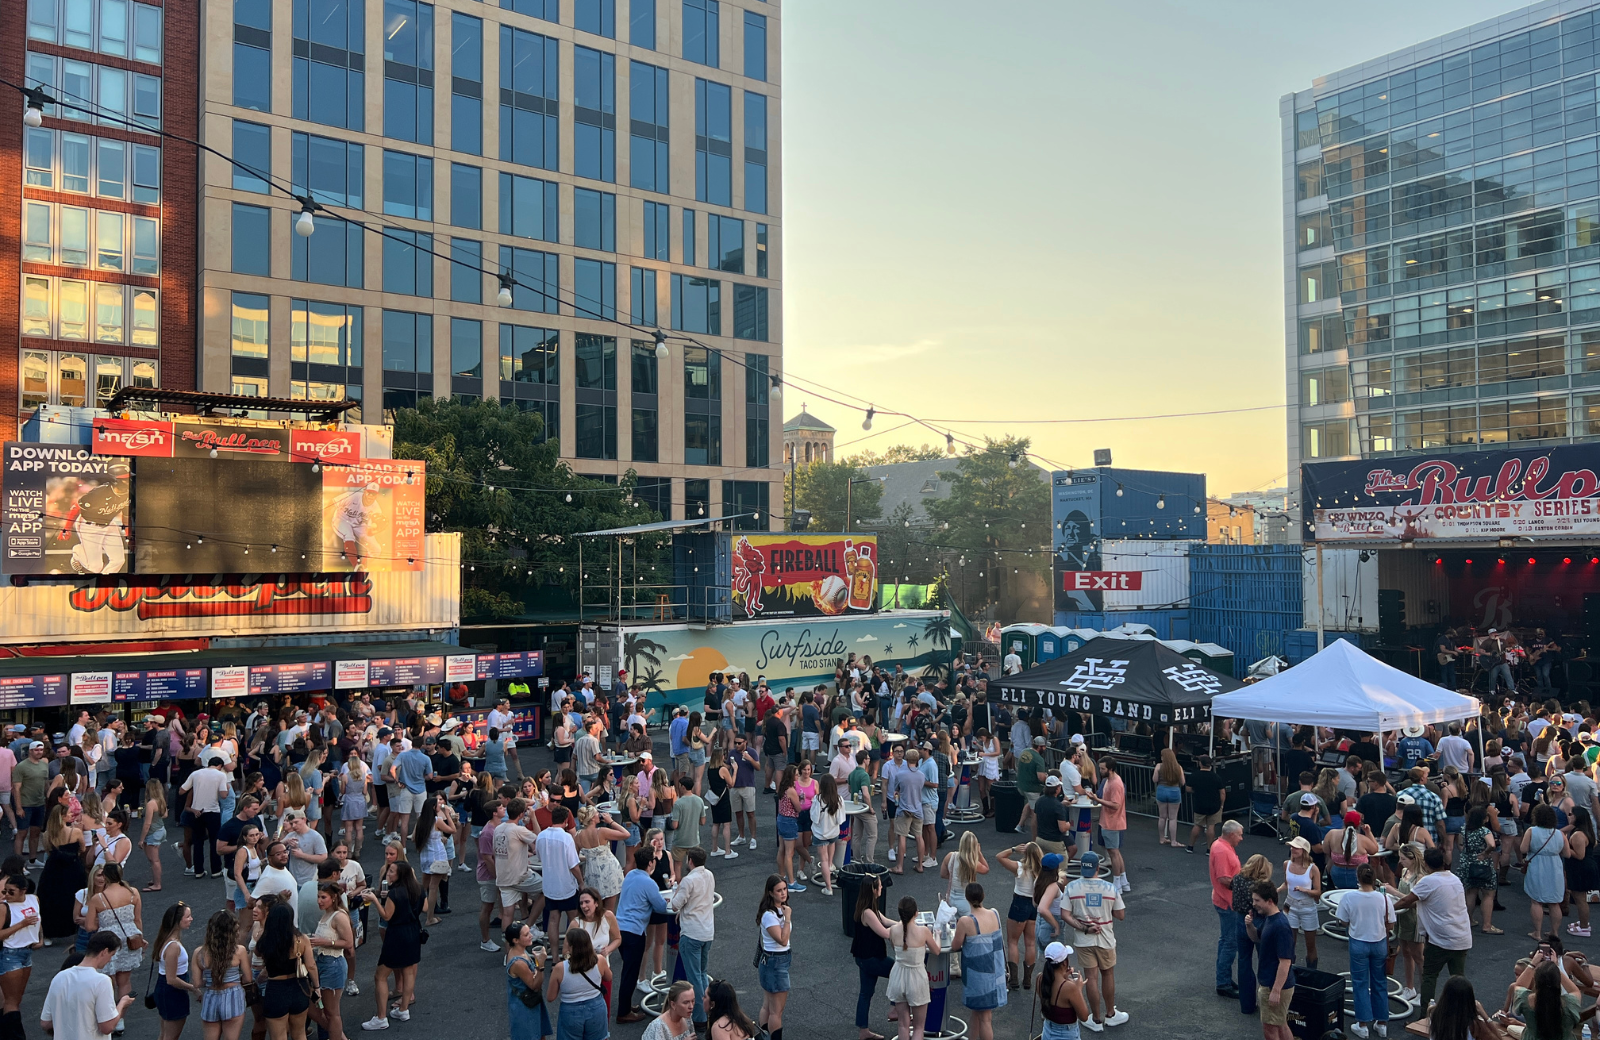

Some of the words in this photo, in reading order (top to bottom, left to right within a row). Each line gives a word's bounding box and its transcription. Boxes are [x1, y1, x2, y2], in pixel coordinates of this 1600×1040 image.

[195, 430, 281, 450] Bullpen
[296, 437, 352, 457] masn
[10, 460, 45, 472] APP
[48, 461, 108, 474] TODAY!
[322, 464, 395, 475] OWNLOAD
[395, 466, 421, 475] THE
[346, 475, 375, 484] APP
[377, 476, 421, 486] TODAY!
[1365, 469, 1408, 490] The
[1401, 456, 1600, 506] Bullp
[9, 497, 42, 507] LIVE
[396, 507, 420, 516] LIVE
[1347, 511, 1385, 521] WMZQ
[1434, 503, 1523, 520] COUNTRY
[1534, 499, 1591, 517] SERIES
[9, 522, 43, 534] APP
[396, 528, 420, 538] APP
[771, 549, 840, 575] FIREBALL
[1074, 573, 1130, 590] Exit
[756, 629, 848, 670] Surfside
[799, 660, 818, 670] TACO
[1001, 687, 1026, 703] ELI
[1037, 690, 1091, 711] YOUNG
[1102, 697, 1153, 721] BAND
[1174, 706, 1196, 721] ELI
[1407, 748, 1422, 760] 29
[1295, 1019, 1306, 1027] TIME
